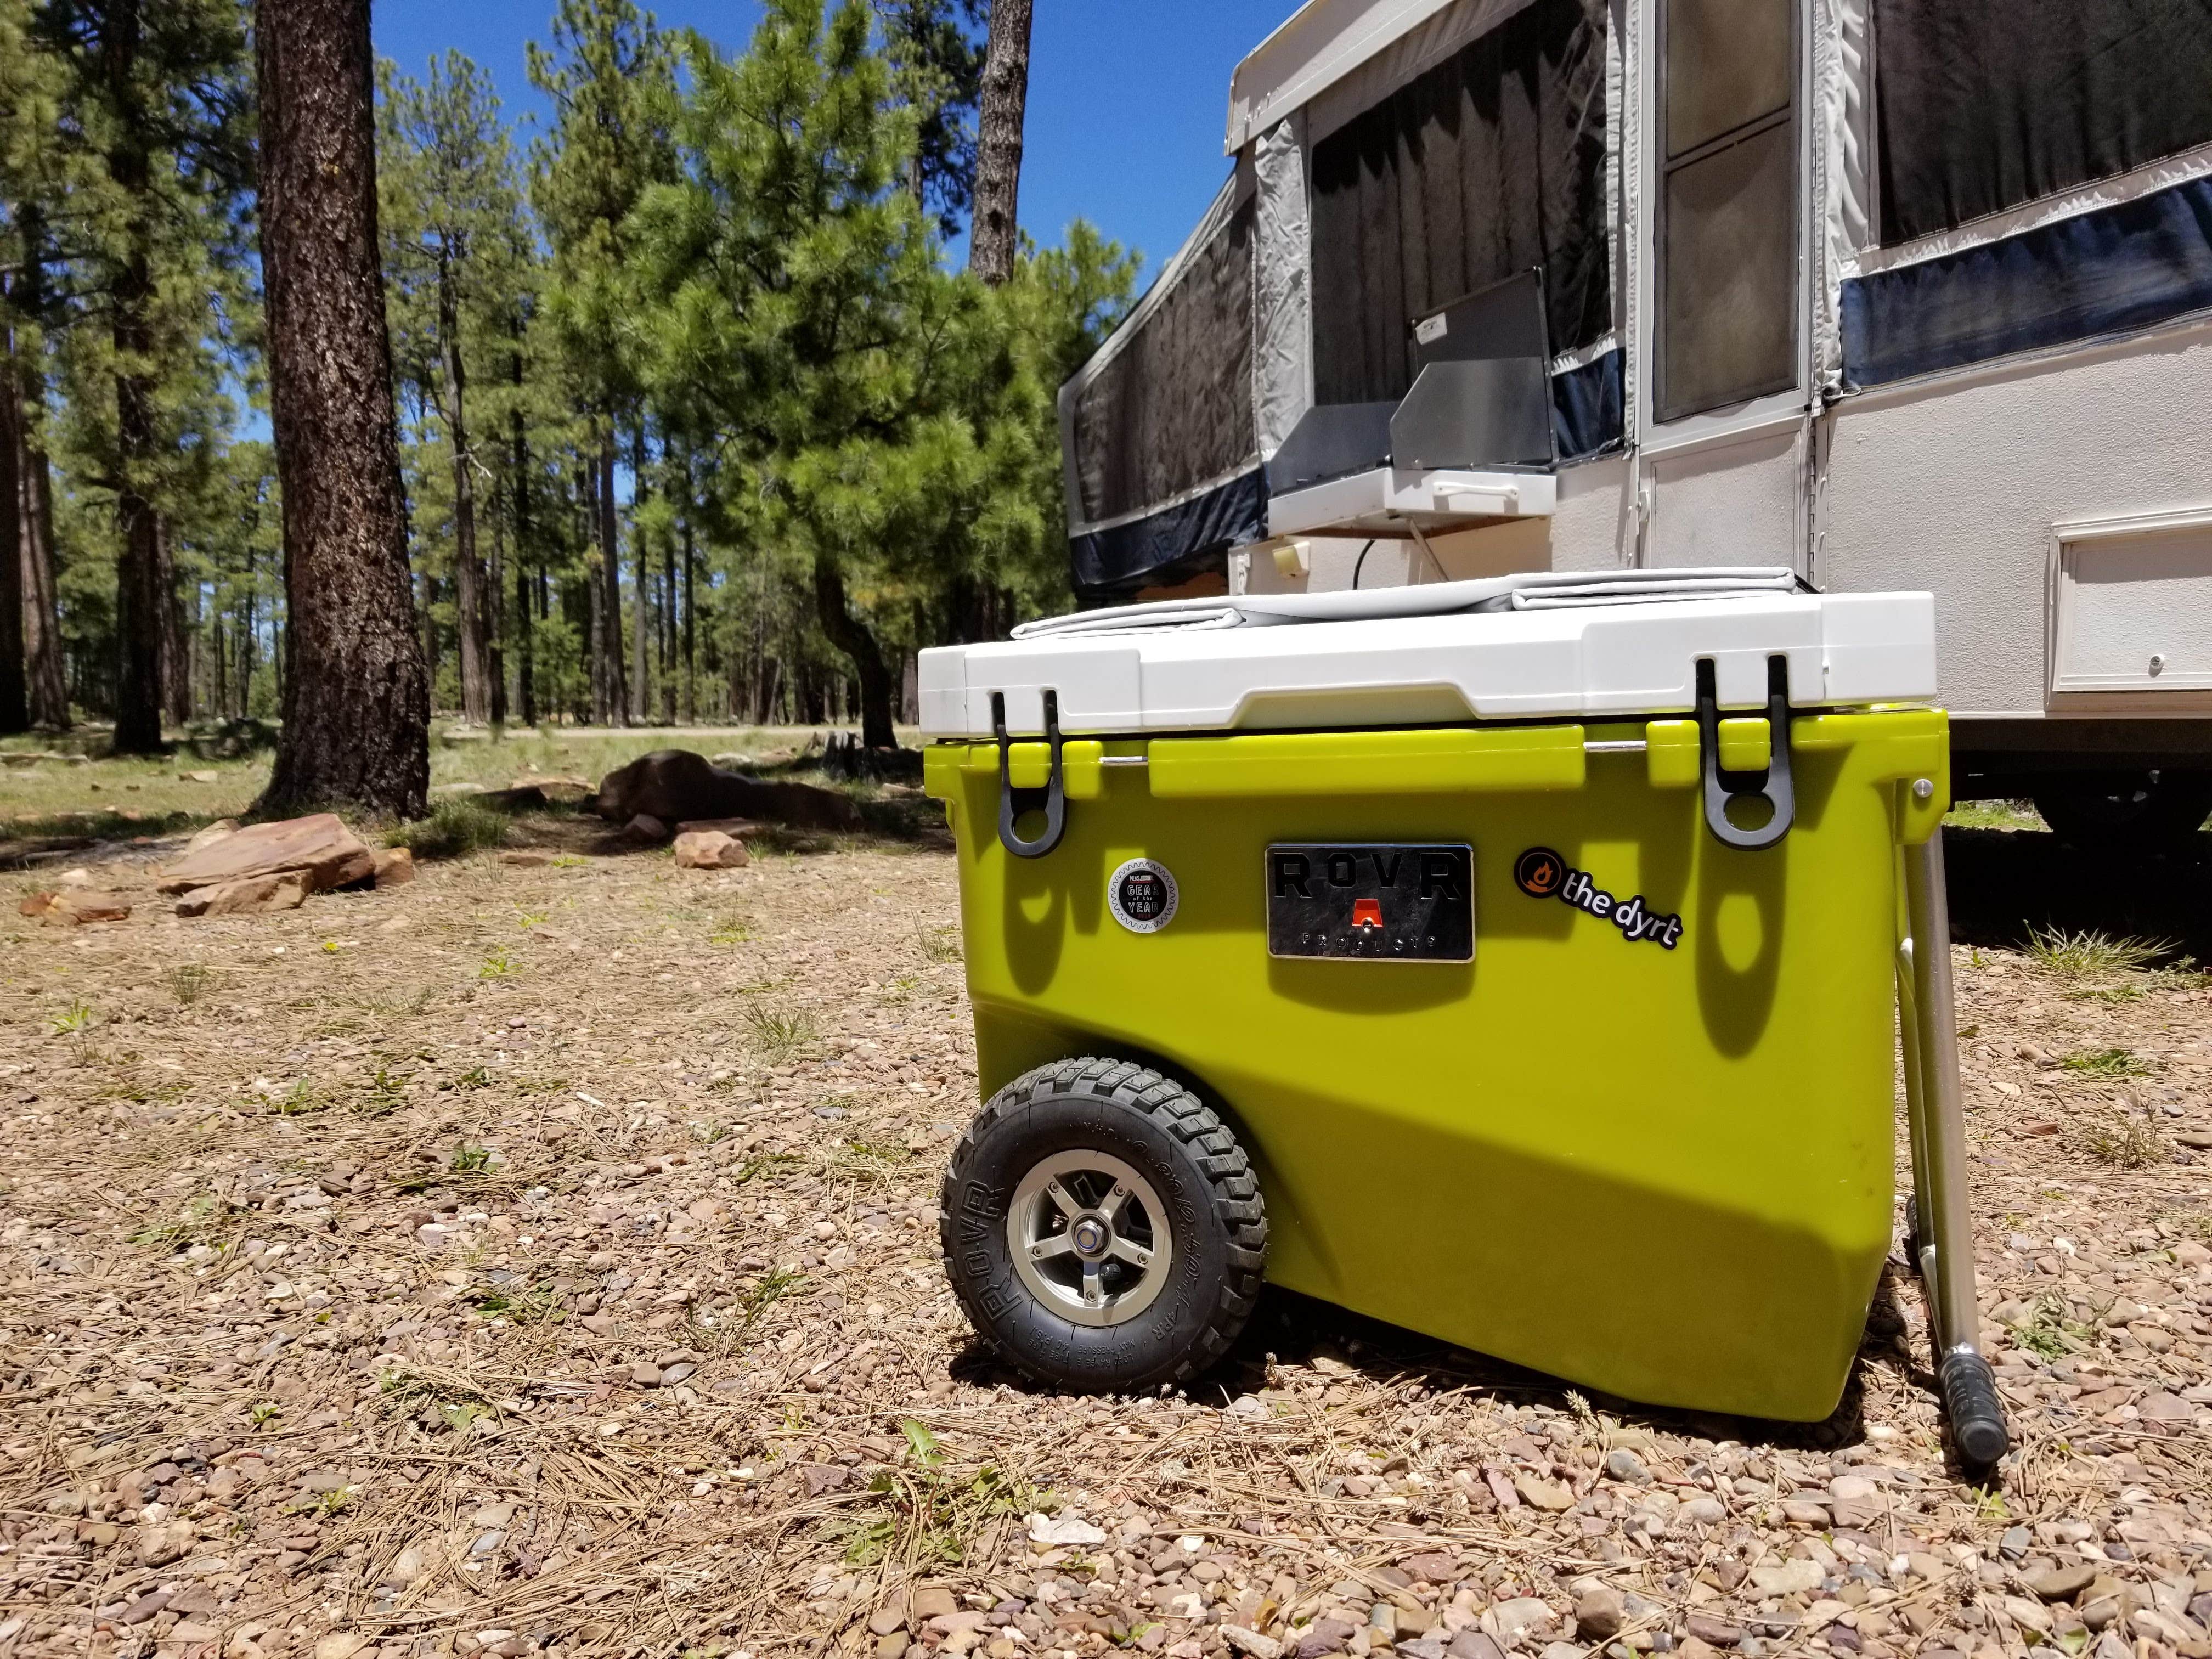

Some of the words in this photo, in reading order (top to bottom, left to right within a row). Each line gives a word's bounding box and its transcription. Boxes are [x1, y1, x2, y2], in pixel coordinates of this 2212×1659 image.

[1127, 884, 1159, 896] GEAR
[1273, 853, 1462, 900] ROVR
[1128, 902, 1159, 913] YEAR
[1562, 873, 1611, 914] the
[1615, 899, 1679, 946] dyrt
[1302, 933, 1436, 951] PRODUCTS
[960, 1180, 1024, 1319] ROVR
